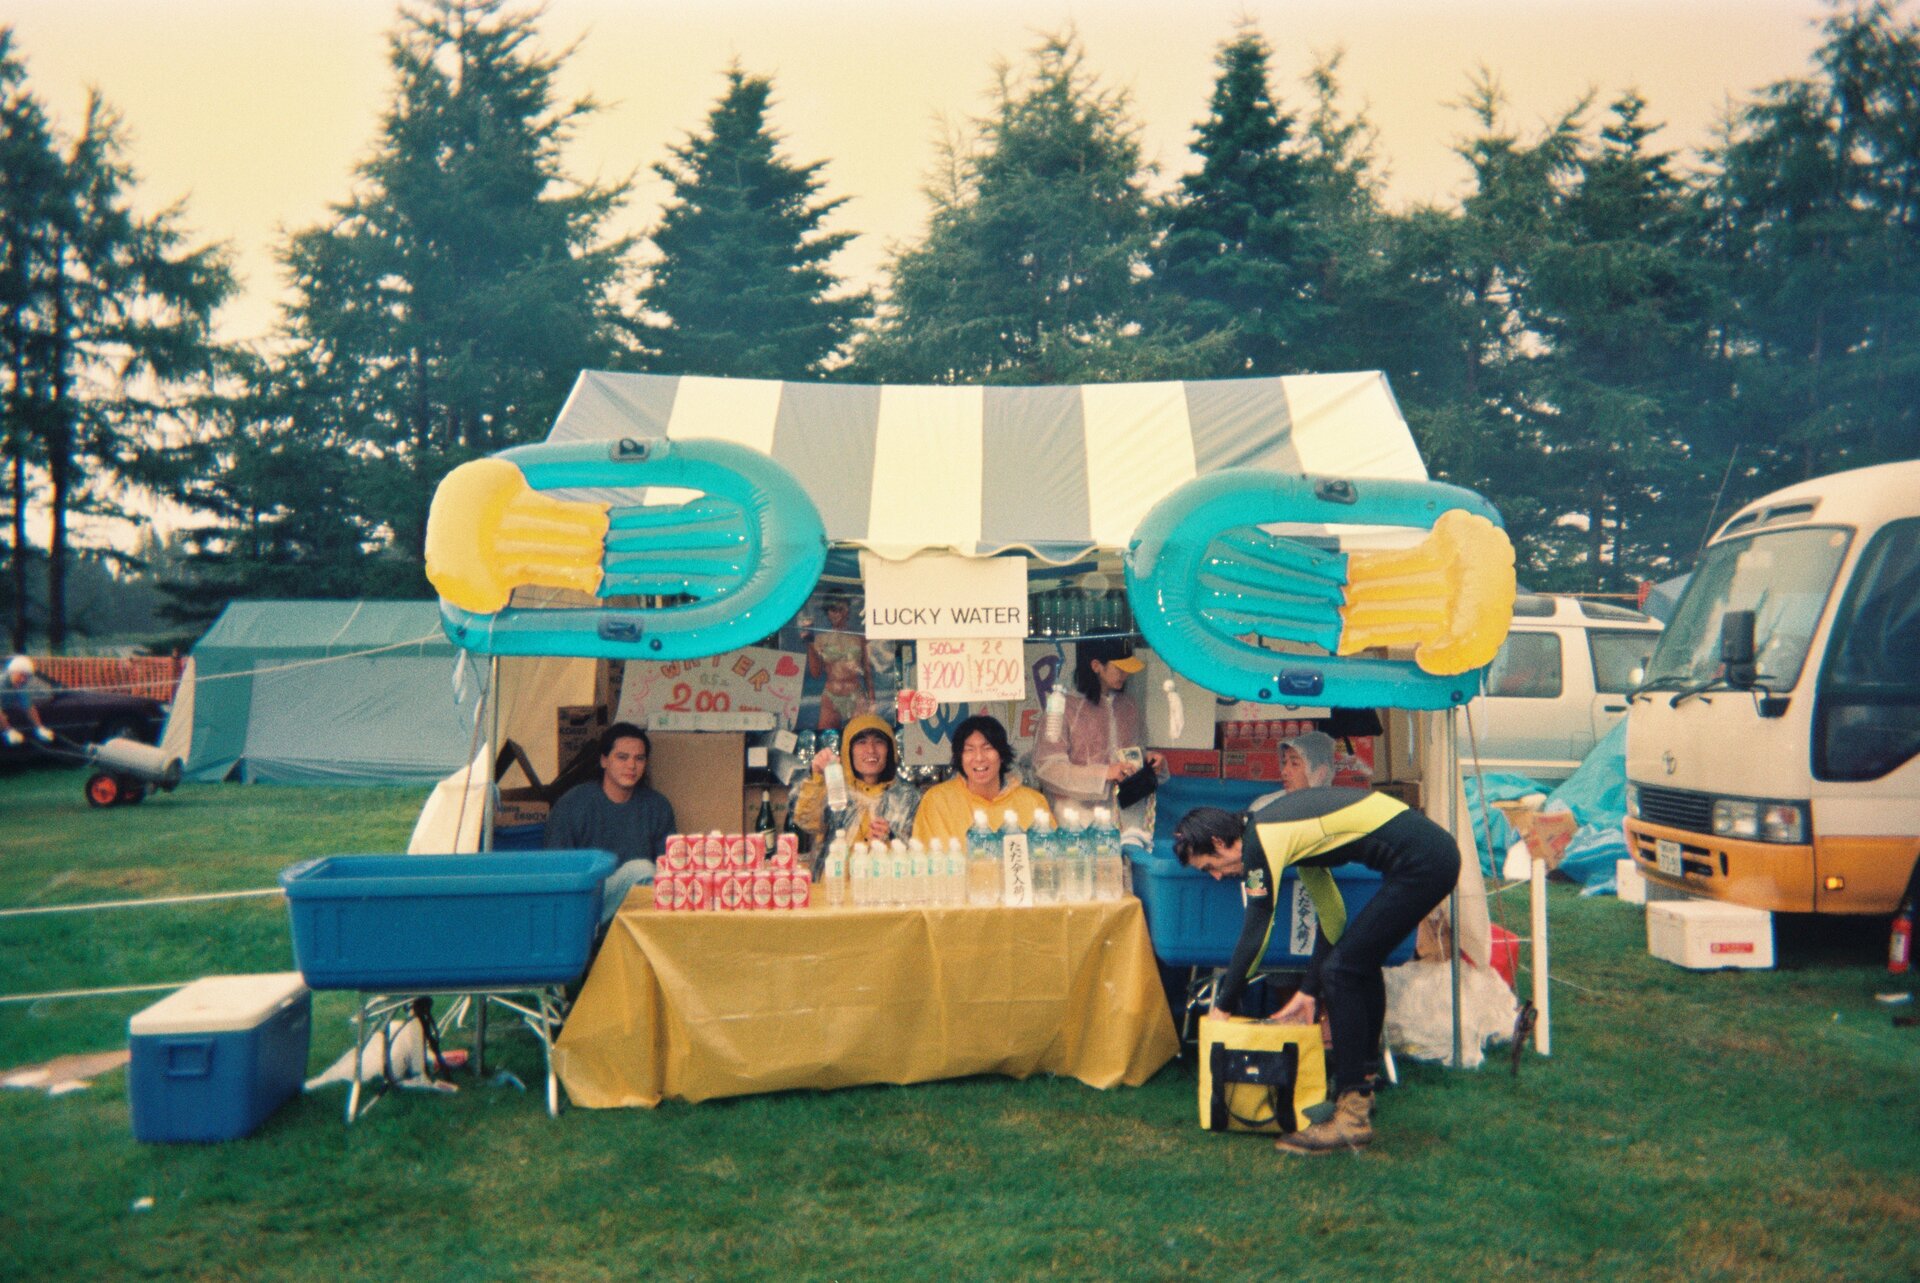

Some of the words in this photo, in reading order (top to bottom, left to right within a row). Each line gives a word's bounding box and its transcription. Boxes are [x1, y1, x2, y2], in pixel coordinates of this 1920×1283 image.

[872, 607, 942, 626] LUCKY
[951, 607, 1021, 625] WATER
[661, 654, 771, 692] WER
[923, 661, 965, 690] ¥200
[975, 659, 1019, 688] ¥500
[663, 682, 732, 712] 200
